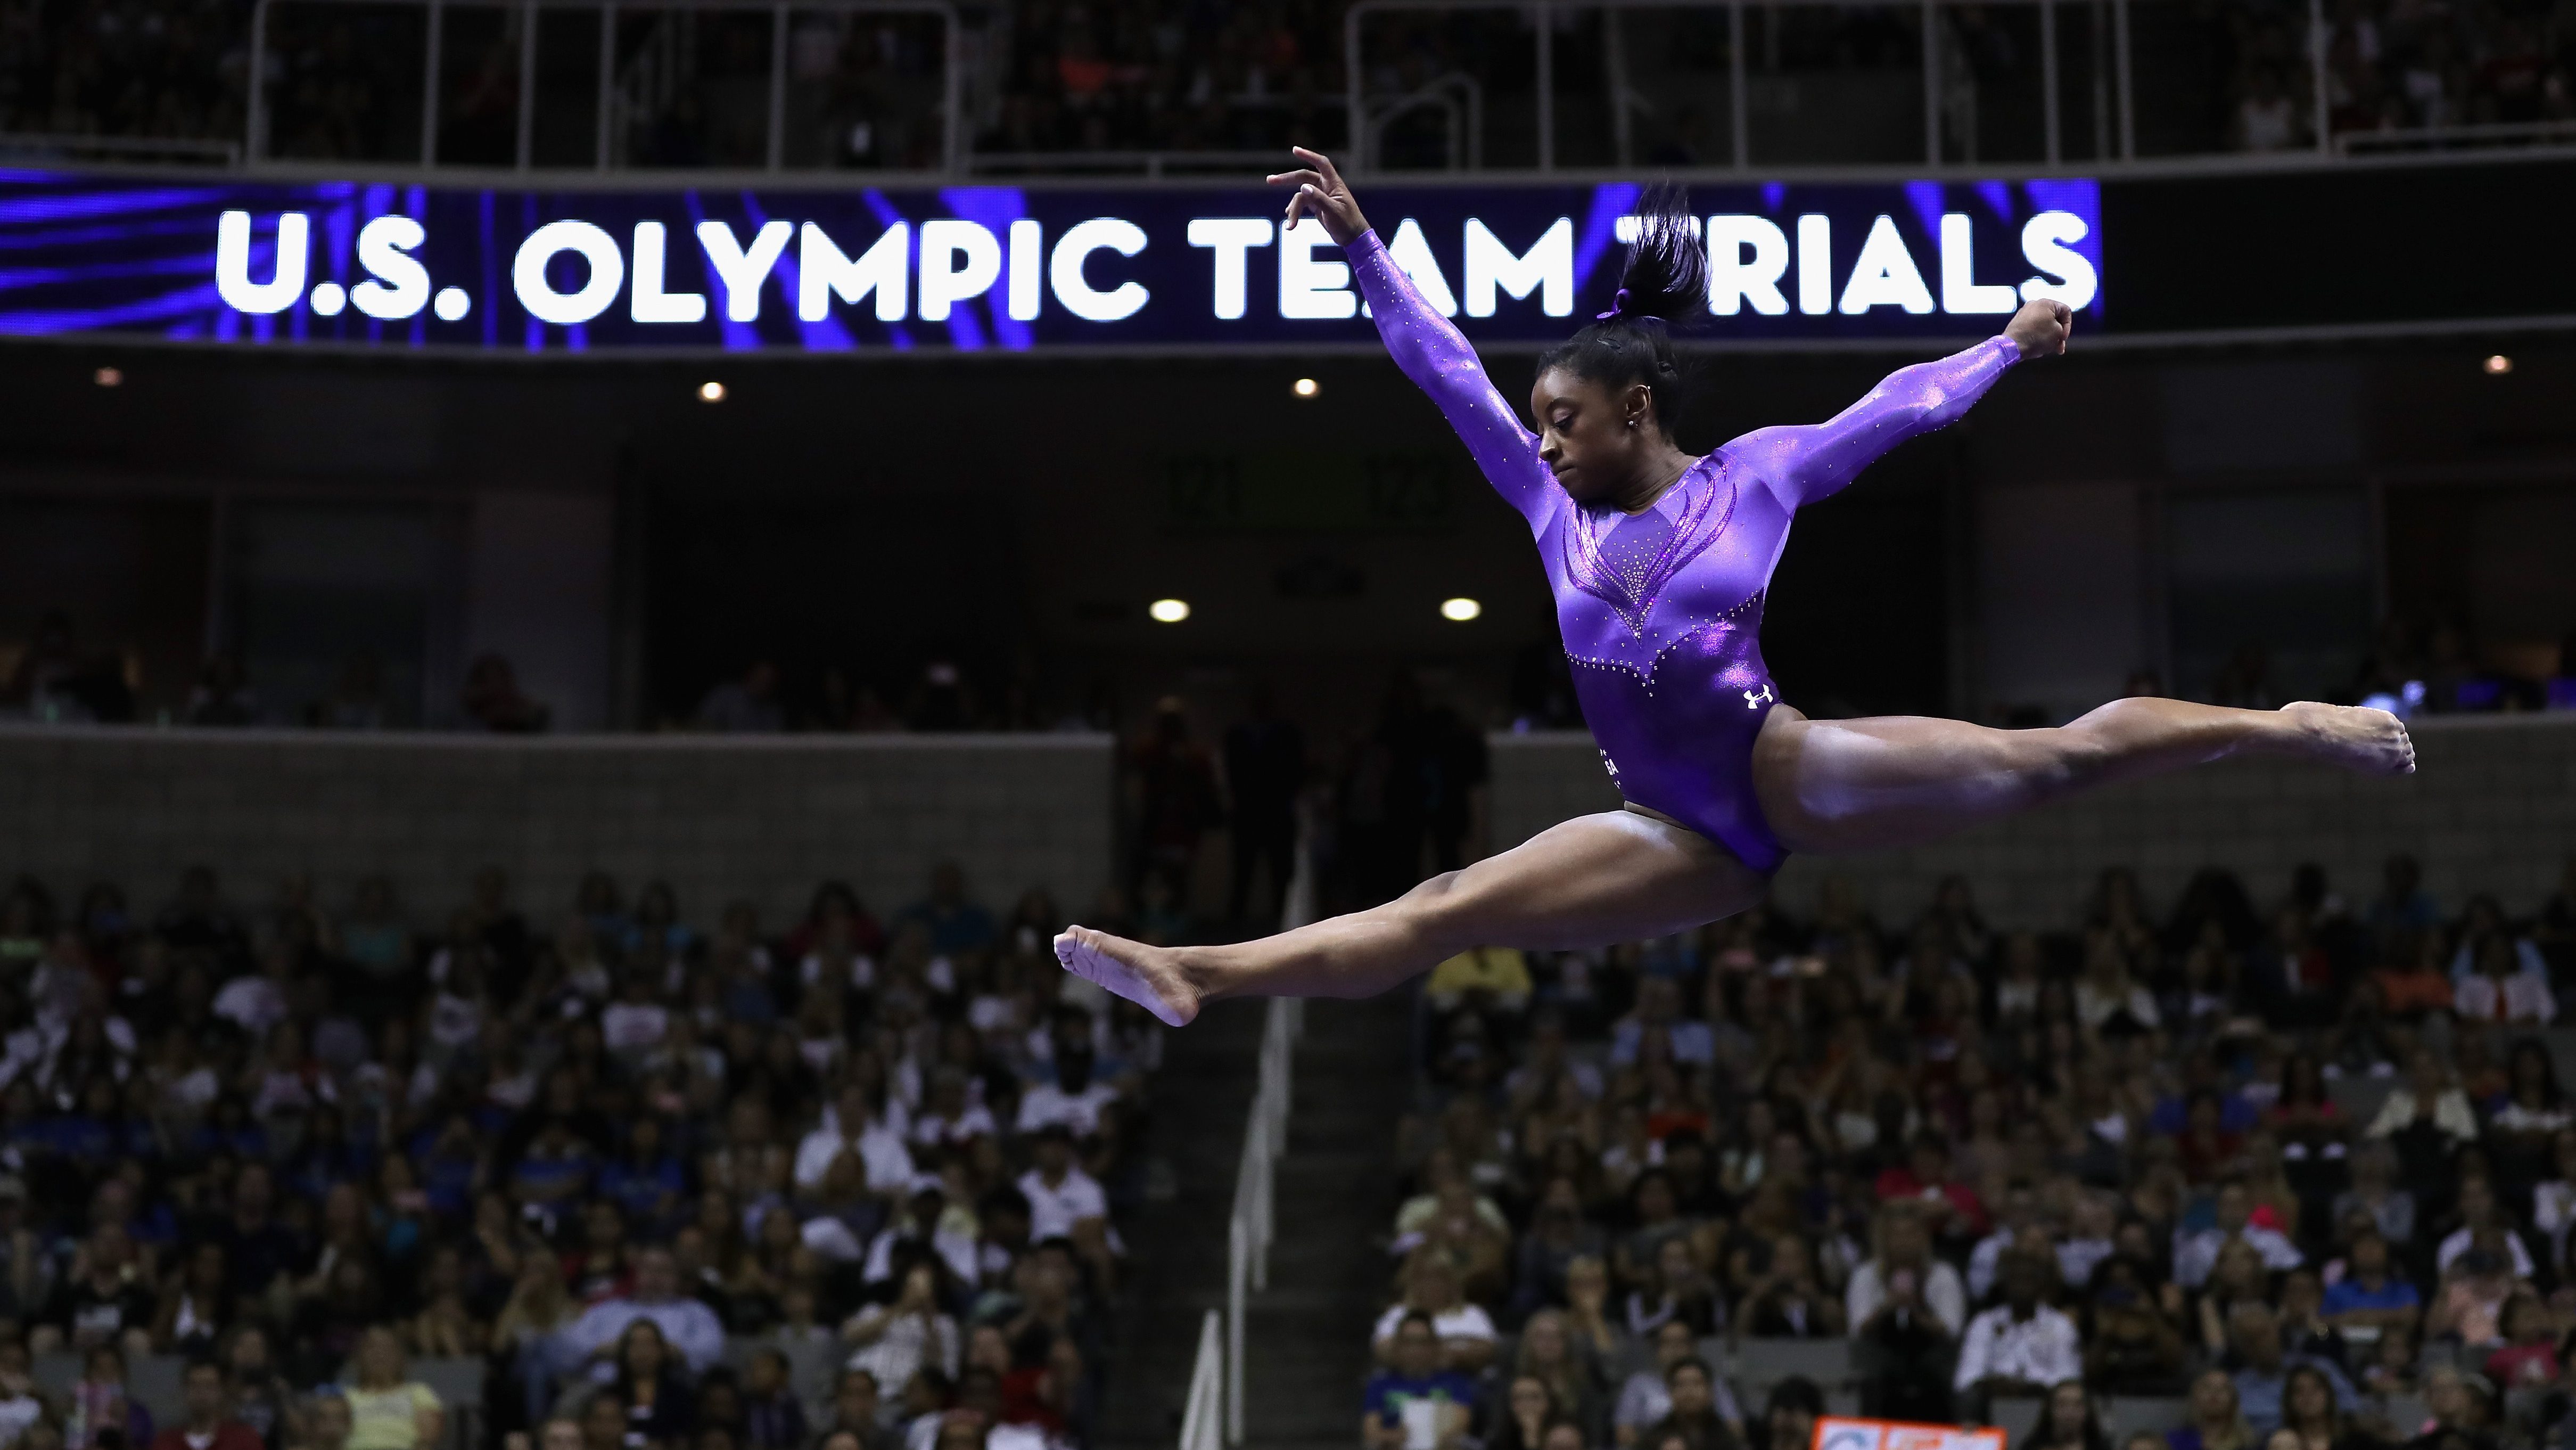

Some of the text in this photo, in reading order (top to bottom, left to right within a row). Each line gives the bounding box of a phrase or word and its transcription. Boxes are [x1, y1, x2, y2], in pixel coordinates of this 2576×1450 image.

[213, 209, 472, 322] U.S.
[513, 215, 1151, 324] OLYMPIC
[1187, 217, 1574, 320] TEAM
